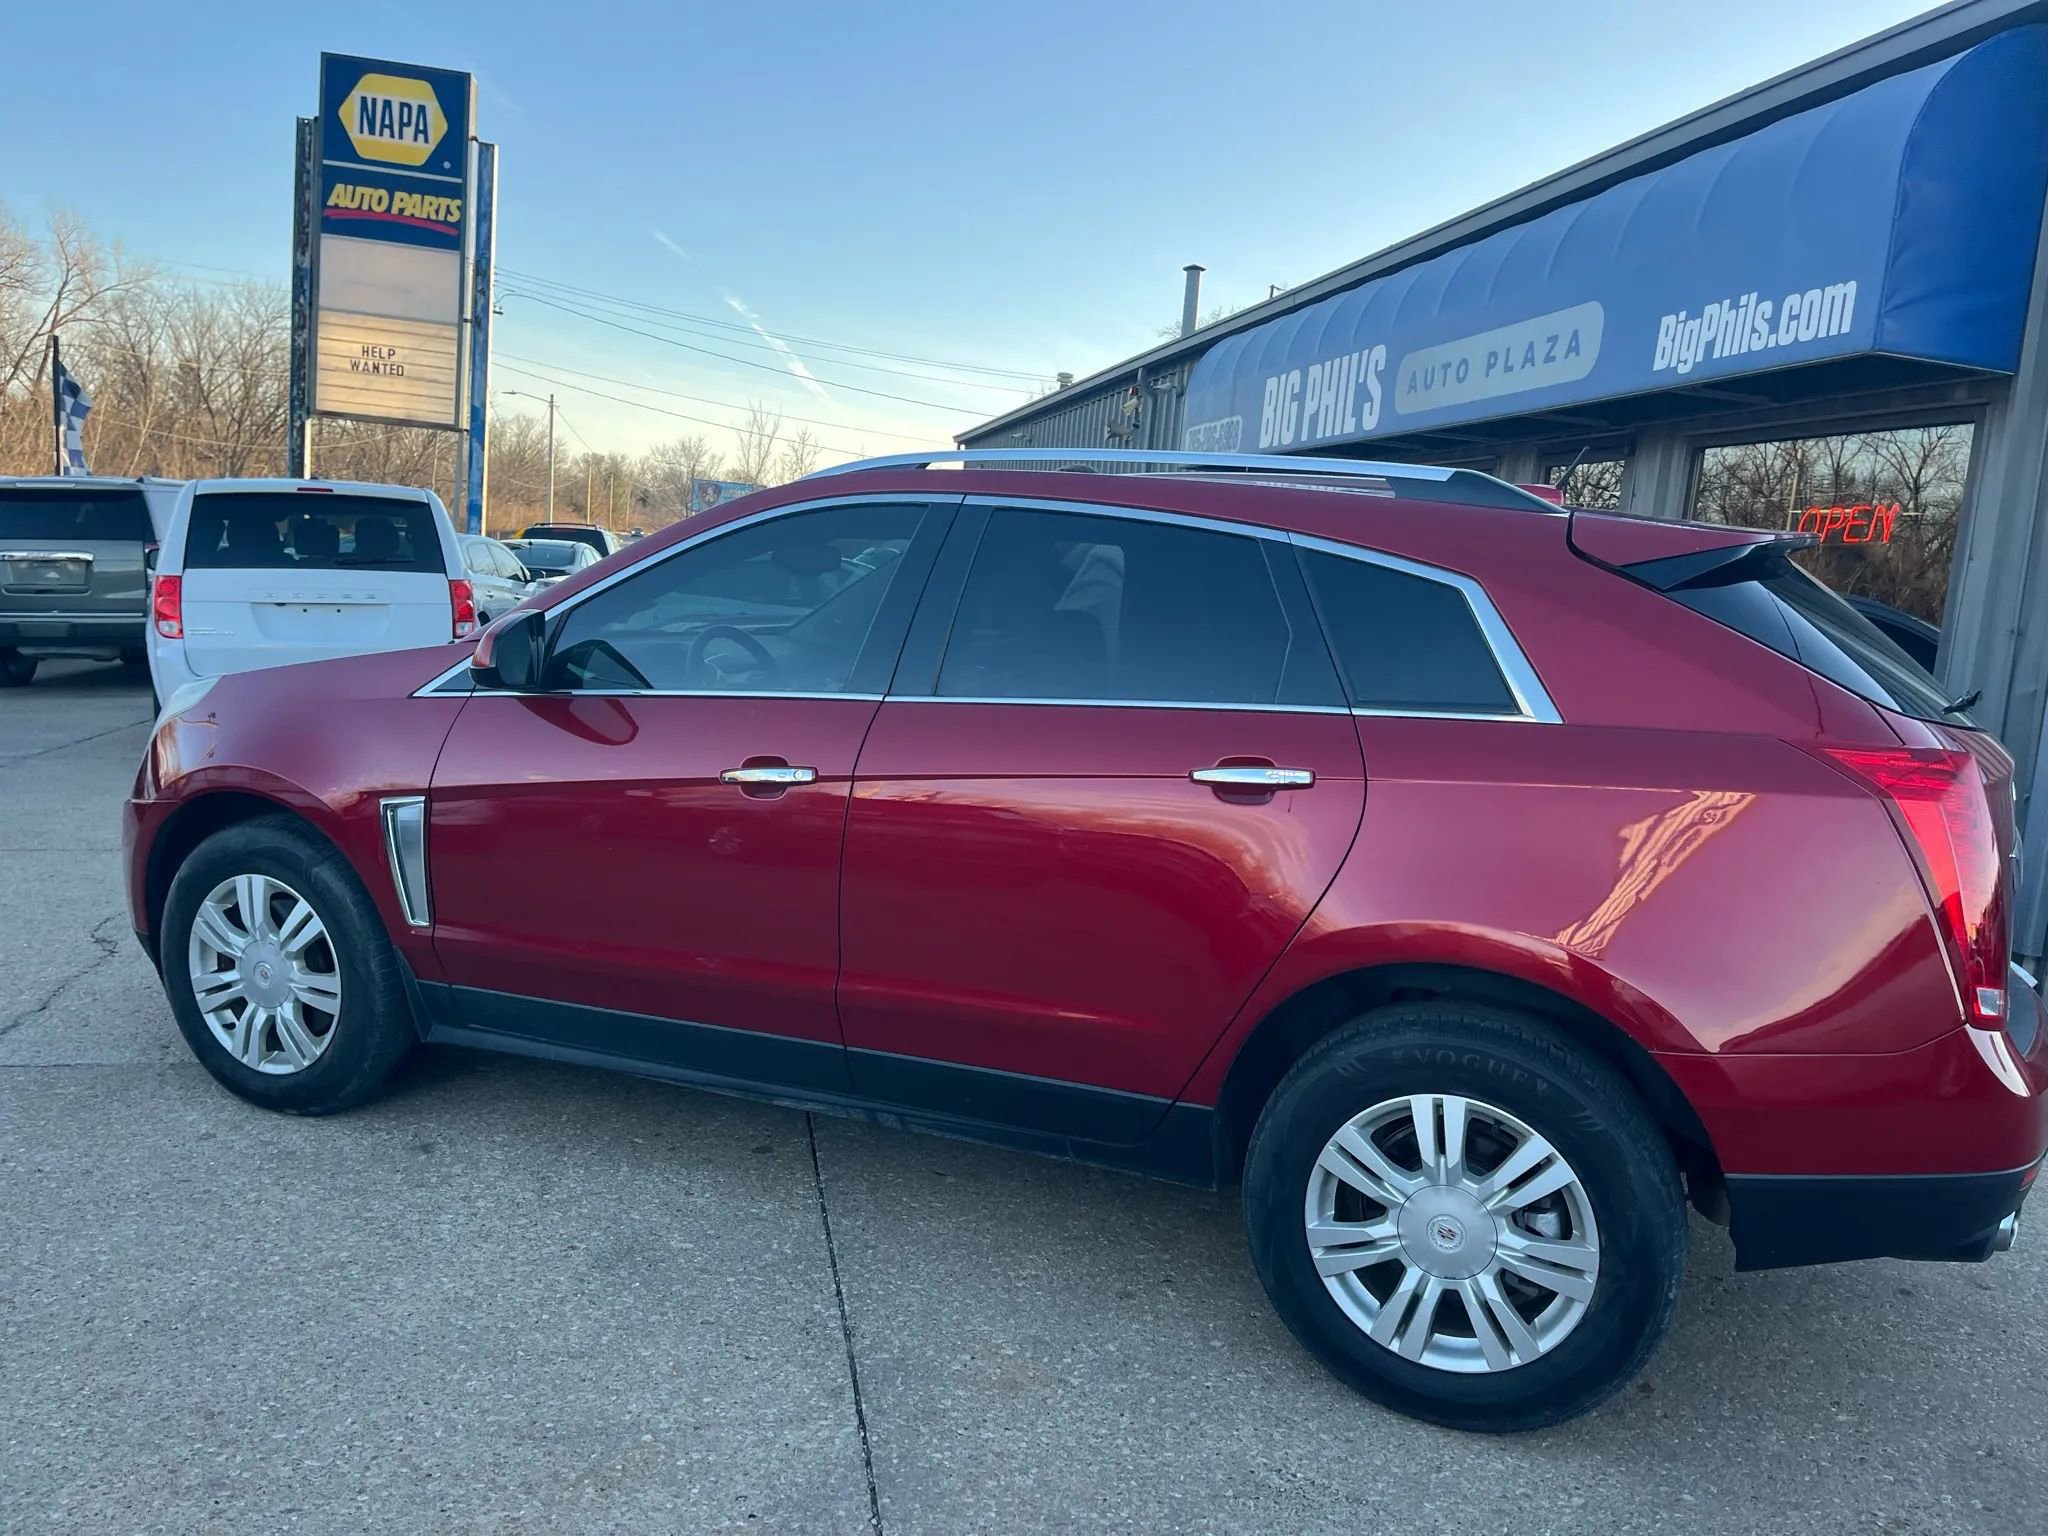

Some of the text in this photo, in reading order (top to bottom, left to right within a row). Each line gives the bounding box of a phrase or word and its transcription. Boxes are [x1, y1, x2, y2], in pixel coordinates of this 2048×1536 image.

[359, 95, 429, 144] NAPA
[327, 183, 462, 223] AUTO PARTS
[1652, 280, 1857, 375] BigPhils.com
[350, 359, 404, 377] WANTED
[361, 345, 396, 360] HELP
[1258, 329, 1581, 449] BIG PHIL'S AUTO PLAZA
[1797, 502, 1900, 544] OPEN
[1414, 1048, 1529, 1084] VOGUE
